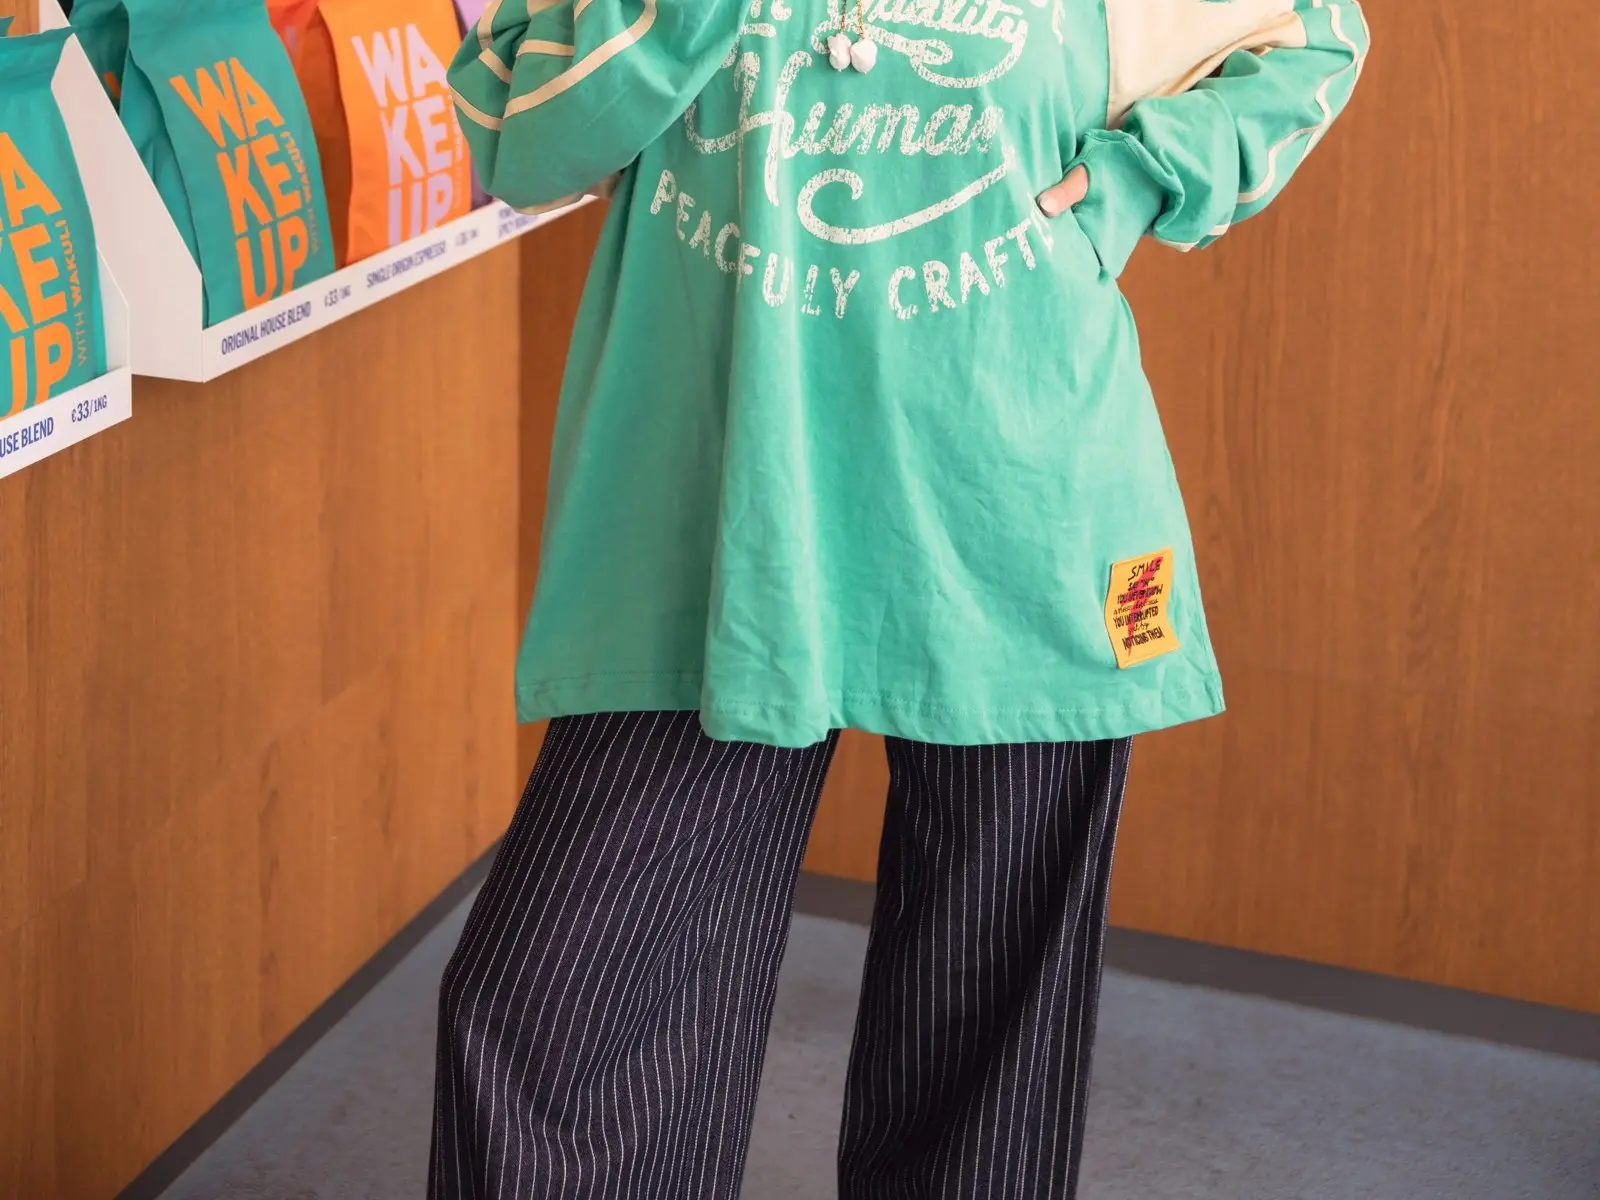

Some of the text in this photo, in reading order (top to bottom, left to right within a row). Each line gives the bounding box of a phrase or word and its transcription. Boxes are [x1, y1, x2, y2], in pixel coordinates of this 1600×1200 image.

[169, 57, 285, 149] WA
[351, 23, 449, 107] WA
[0, 132, 62, 240] A
[215, 133, 301, 237] KE
[380, 97, 452, 186] KE
[55, 219, 87, 367] WITH WAKULI
[235, 216, 309, 311] UP
[221, 328, 259, 356] ORIGINAL
[260, 313, 286, 337] HOUSE
[287, 300, 312, 325] BLEND
[0, 431, 20, 458] USE
[21, 416, 54, 448] BLEND
[1127, 557, 1162, 581] SMILE
